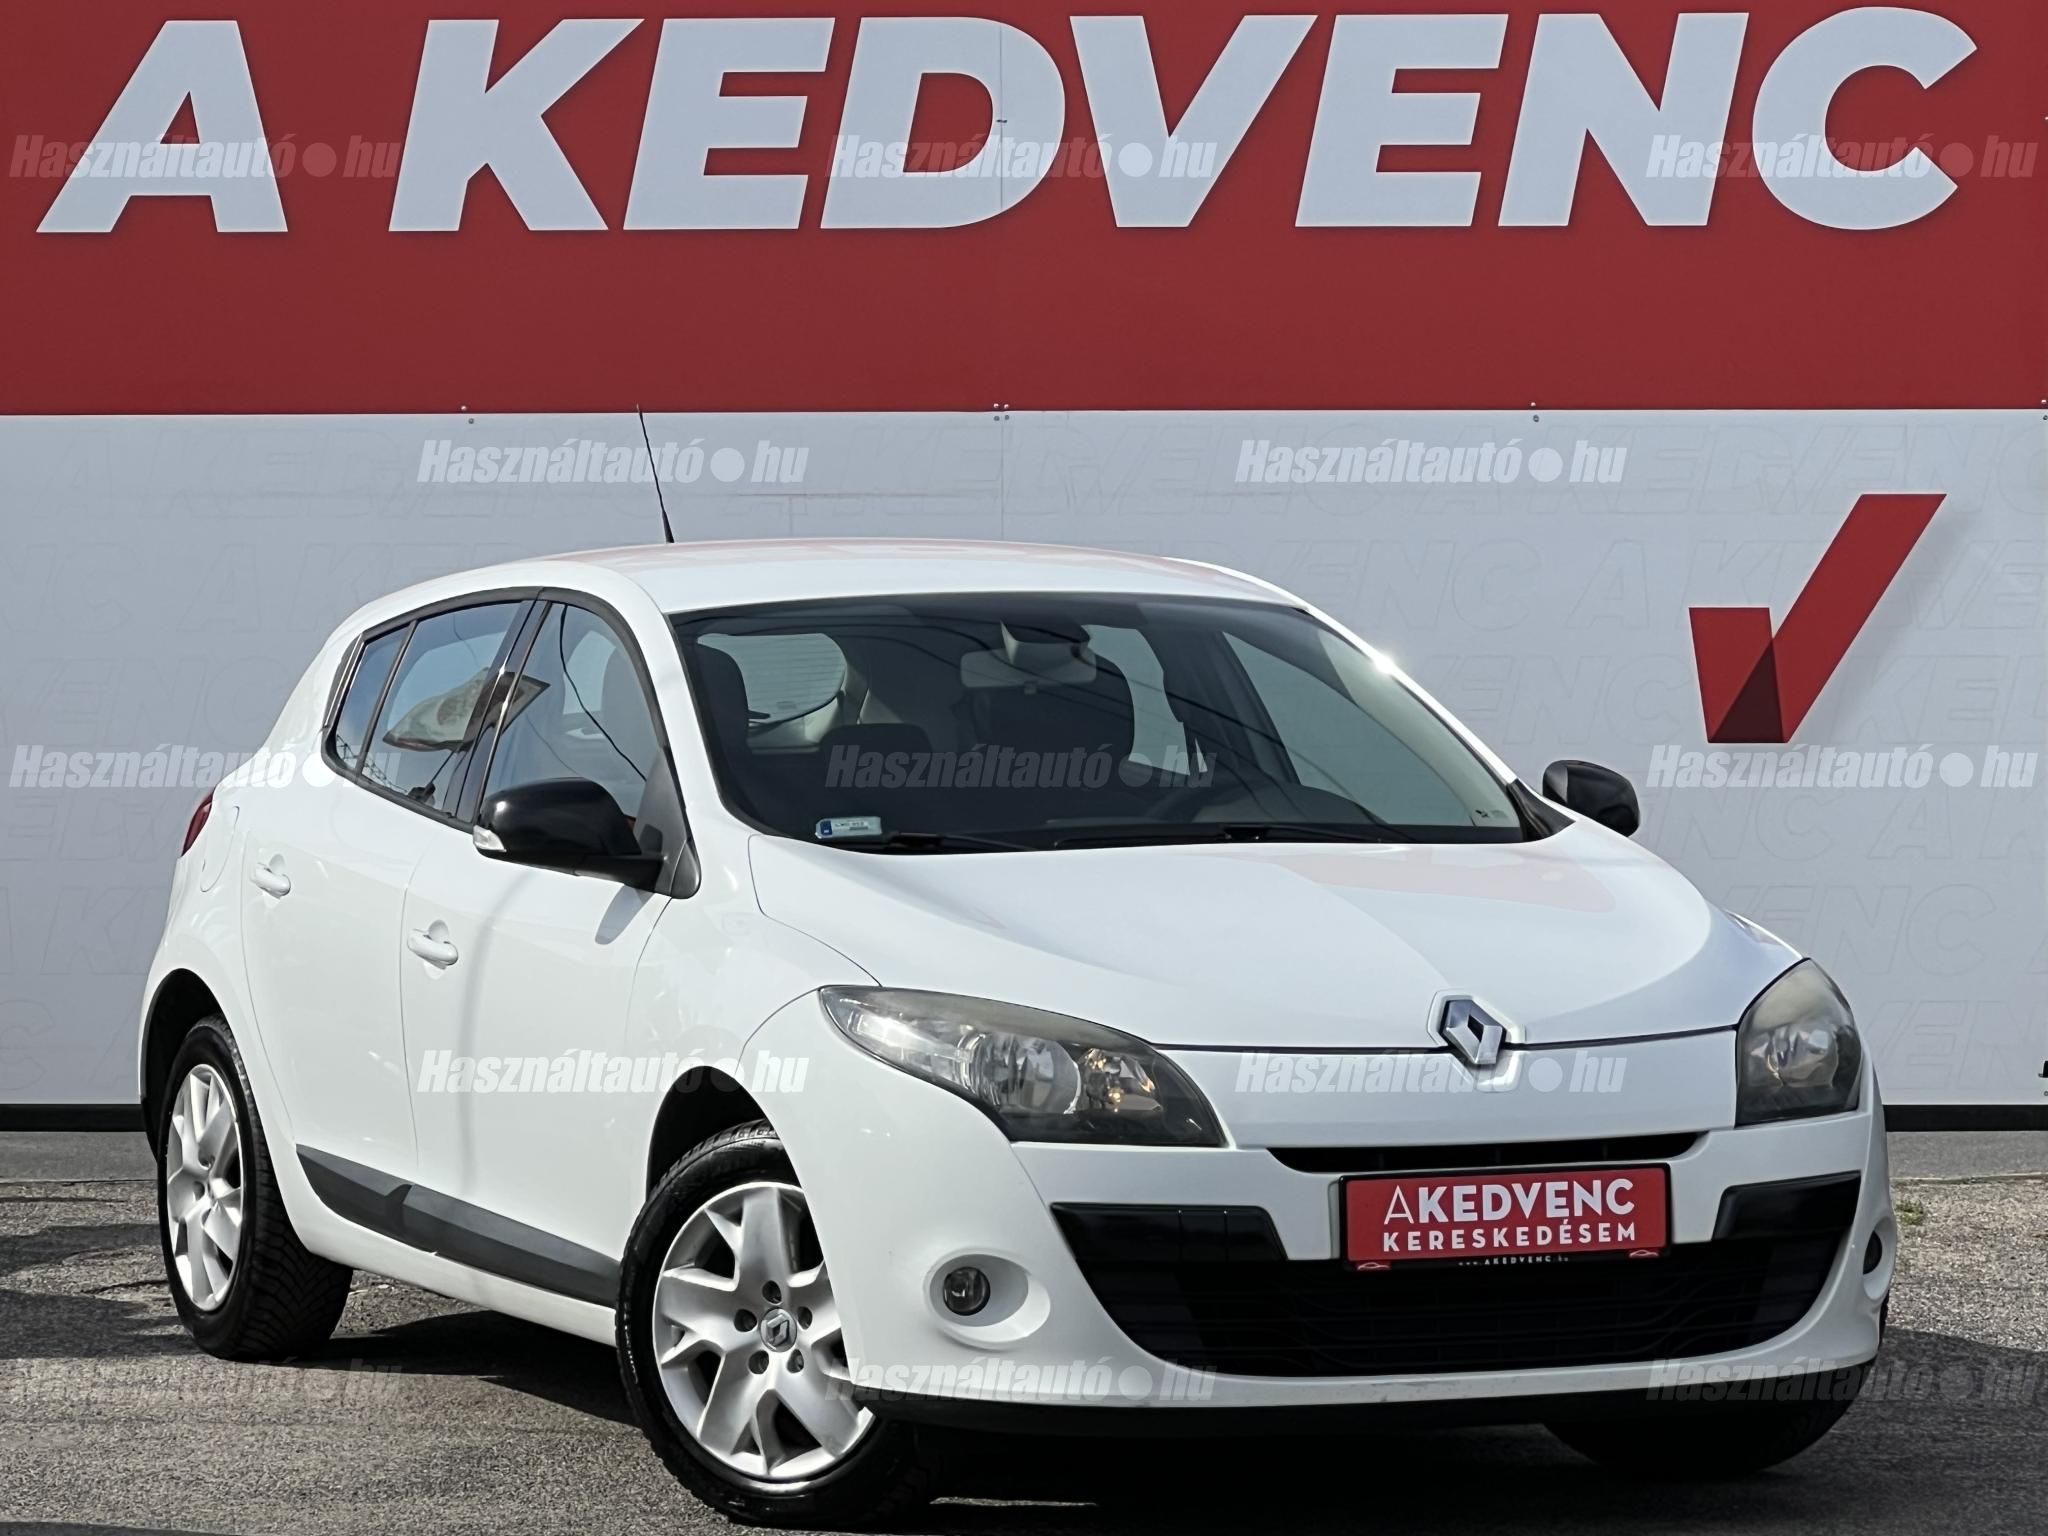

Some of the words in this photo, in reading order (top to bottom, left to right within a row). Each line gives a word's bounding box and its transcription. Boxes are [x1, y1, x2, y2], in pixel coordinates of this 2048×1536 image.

[35, 19, 289, 233] A
[388, 6, 1978, 233] KEDVENC
[1383, 1219, 1636, 1251] KERESKEDÉSEM
